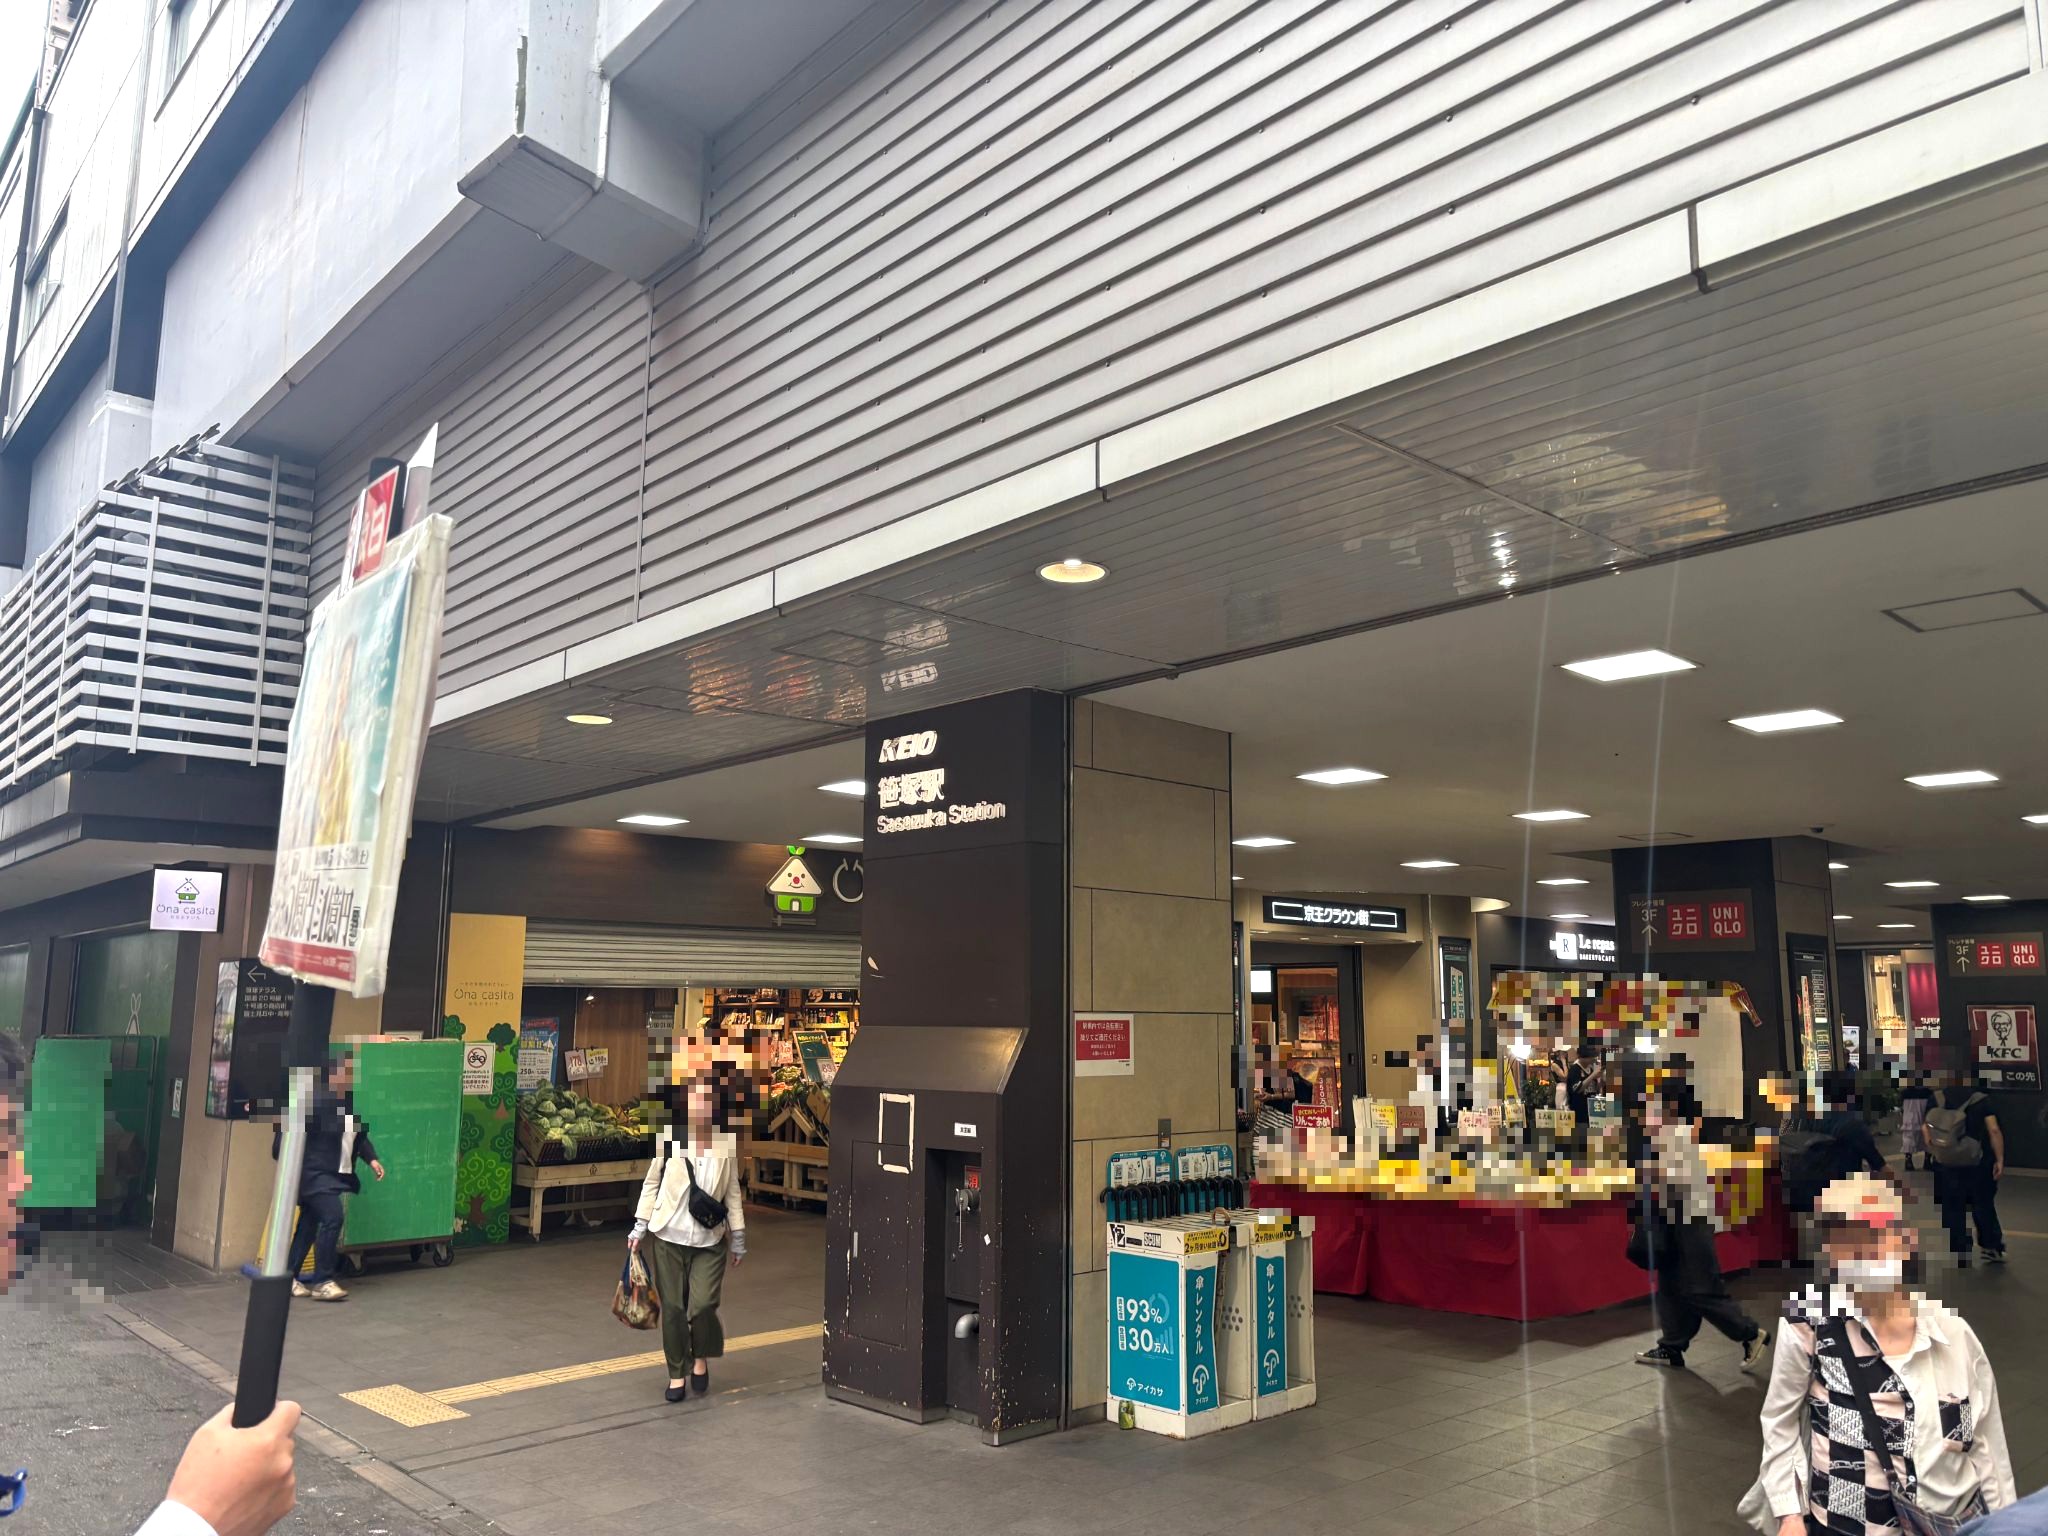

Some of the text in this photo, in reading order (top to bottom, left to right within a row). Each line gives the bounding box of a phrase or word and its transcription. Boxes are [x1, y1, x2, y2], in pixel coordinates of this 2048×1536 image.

[878, 730, 938, 763] KEIO
[878, 768, 945, 809] 笹塚駅
[877, 801, 1006, 834] Sasazuka Station
[183, 905, 216, 916] casita
[1303, 905, 1370, 926] 京王クラウン街
[1641, 909, 1658, 922] 3F
[1955, 945, 1969, 955] 3F
[481, 989, 514, 1001] casita
[1990, 1048, 2022, 1059] KFC
[2006, 1072, 2036, 1081] この先
[1295, 1115, 1331, 1127] りんごあめ
[1265, 1263, 1276, 1340] 傘レンタル
[1126, 1298, 1163, 1324] 93%
[1195, 1275, 1205, 1355] 傘レンタル
[1128, 1327, 1170, 1354] 30万人
[1137, 1383, 1164, 1397] アイカサ
